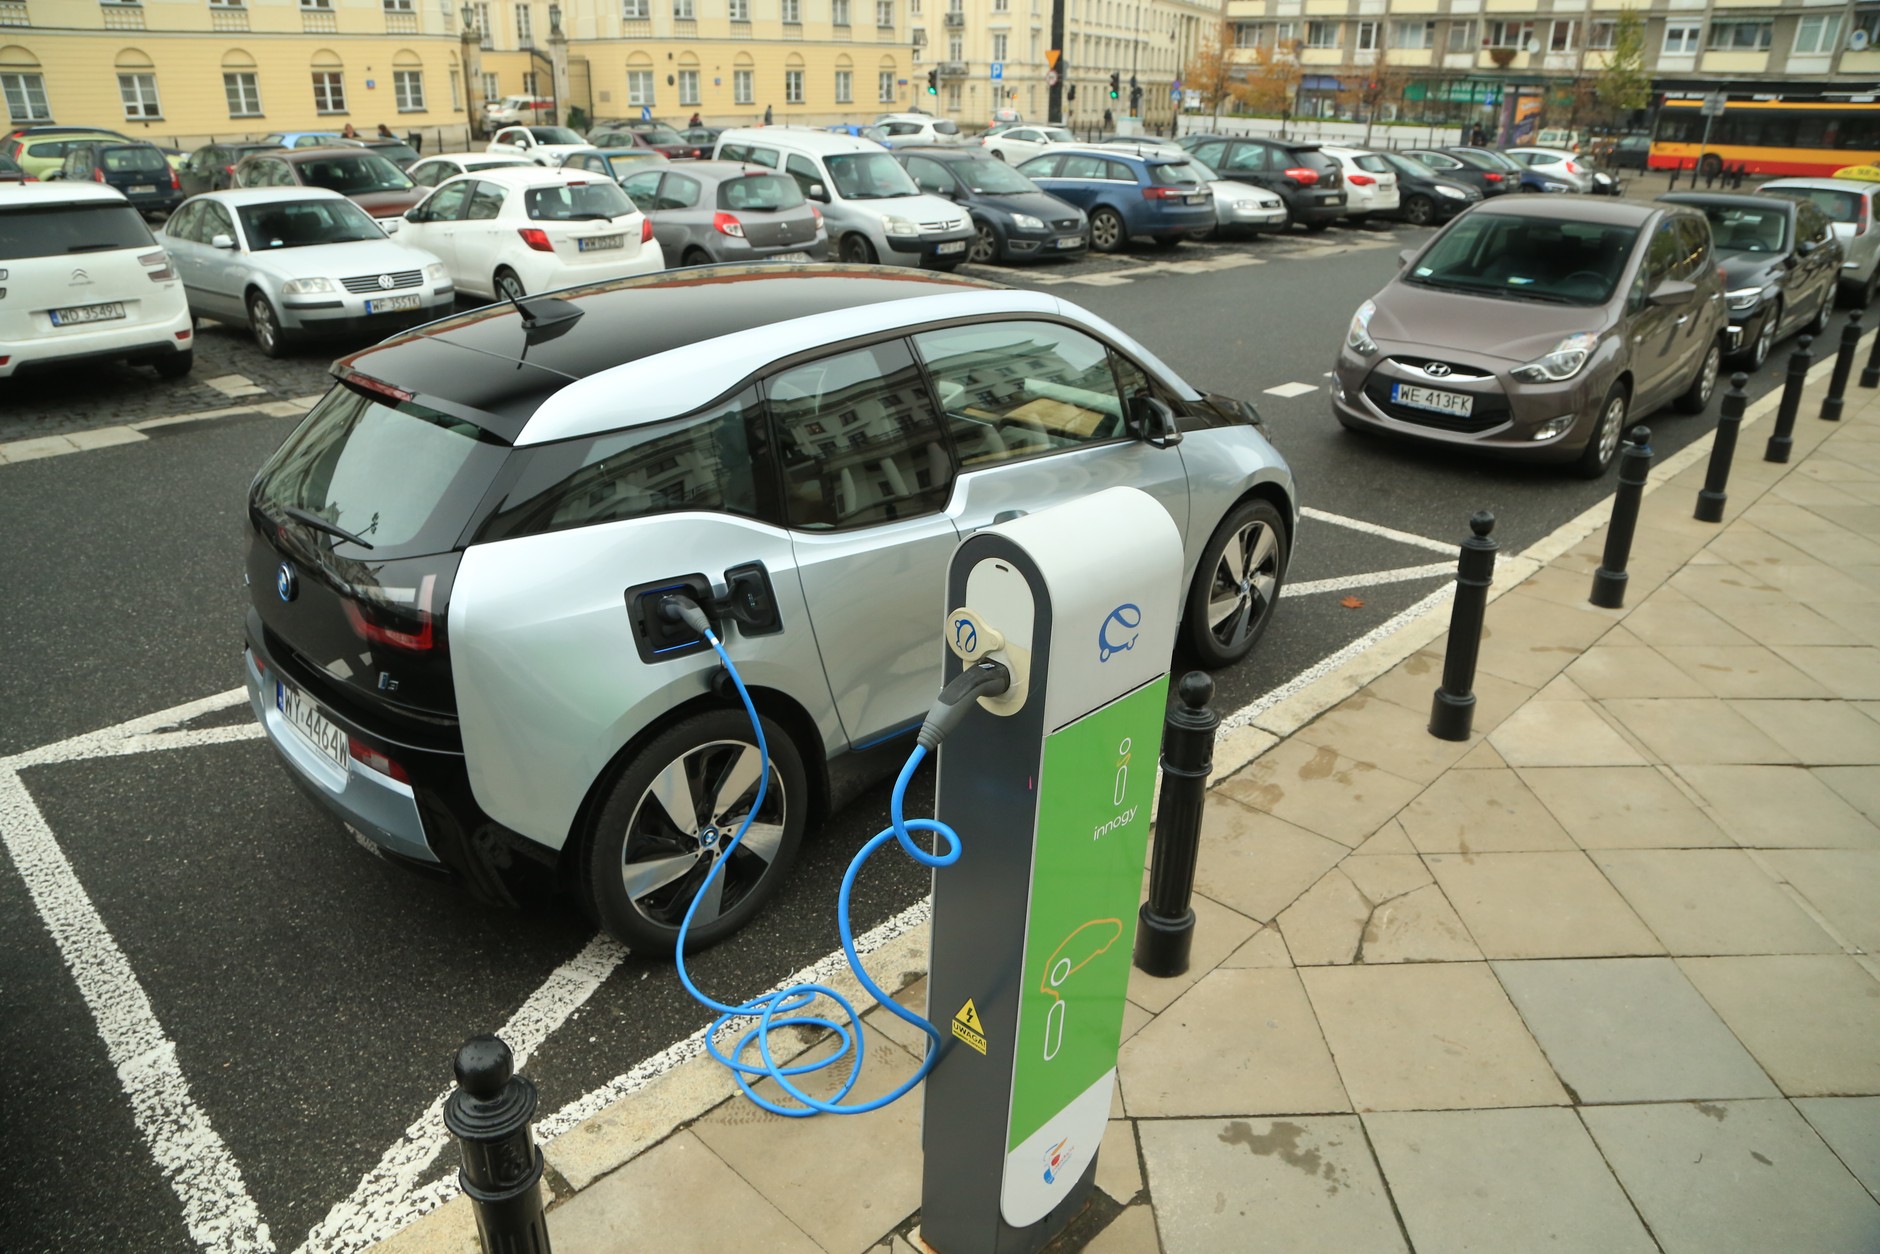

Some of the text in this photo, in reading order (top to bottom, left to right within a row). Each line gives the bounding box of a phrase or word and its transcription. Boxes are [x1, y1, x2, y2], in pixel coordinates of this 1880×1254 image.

[59, 303, 122, 322] WD 3549L
[372, 299, 384, 312] WF
[1400, 386, 1420, 403] WE
[1425, 392, 1470, 412] 413FK
[285, 687, 301, 724] WY
[306, 708, 347, 767] 4464W
[1093, 804, 1138, 841] innogy
[953, 1022, 986, 1048] UWAGA!
